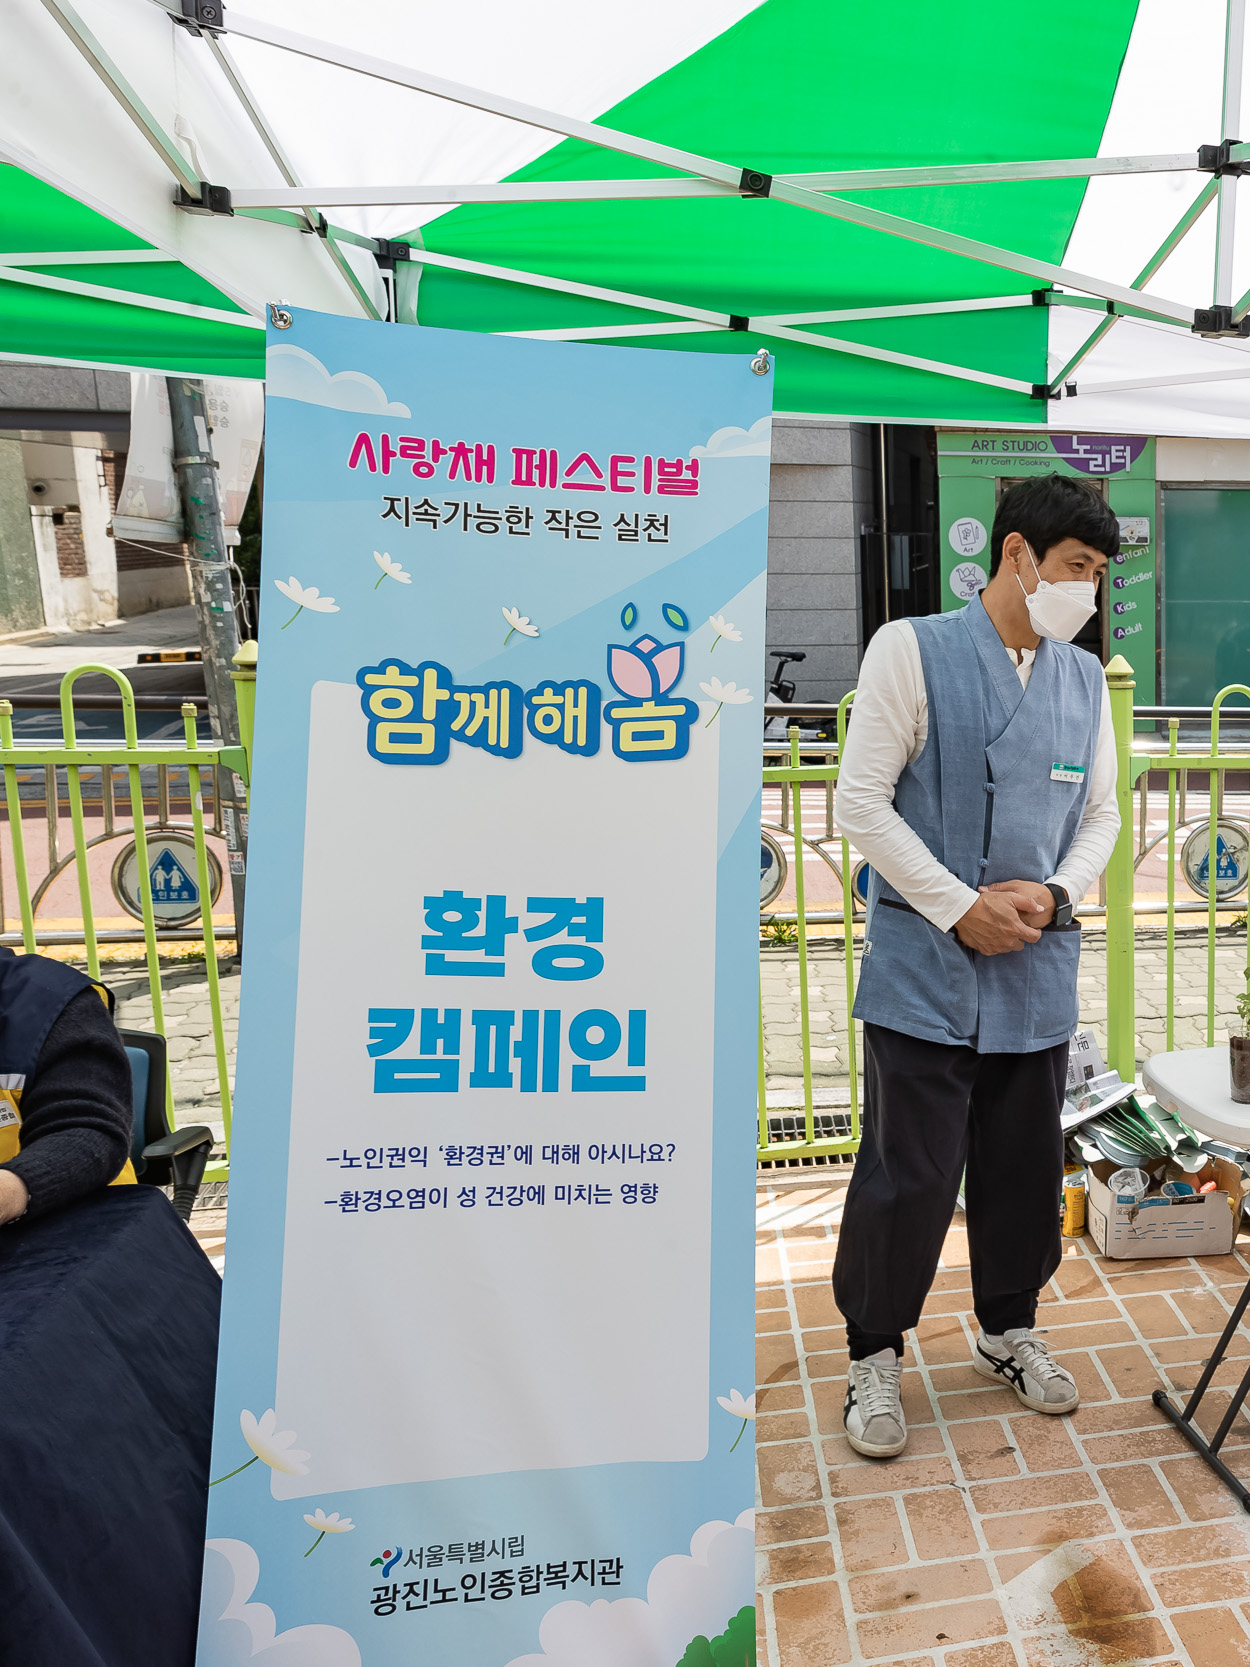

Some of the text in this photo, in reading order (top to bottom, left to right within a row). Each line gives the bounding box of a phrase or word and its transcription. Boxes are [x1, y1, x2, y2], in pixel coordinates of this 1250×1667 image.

[971, 440, 1048, 452] ART STUDIO
[347, 431, 702, 498] 사랑채 페스티벌
[1019, 459, 1051, 467] Cooking
[380, 493, 671, 544] 지속가능한 작은 실천
[1116, 546, 1150, 563] enfant
[1116, 571, 1153, 588] Toddler
[1116, 601, 1137, 613] Kids
[1117, 622, 1143, 638] Adult
[421, 890, 604, 982] 환경
[366, 1007, 647, 1094] 캠페인
[325, 1142, 677, 1171] -노인권익 ‘환경권’에 대해 아시나요?
[323, 1182, 659, 1214] -환경오염이 성 건강에 미치는 영향
[402, 1534, 526, 1571] 서울특별시립
[369, 1557, 625, 1617] 광진노인종합복지관
